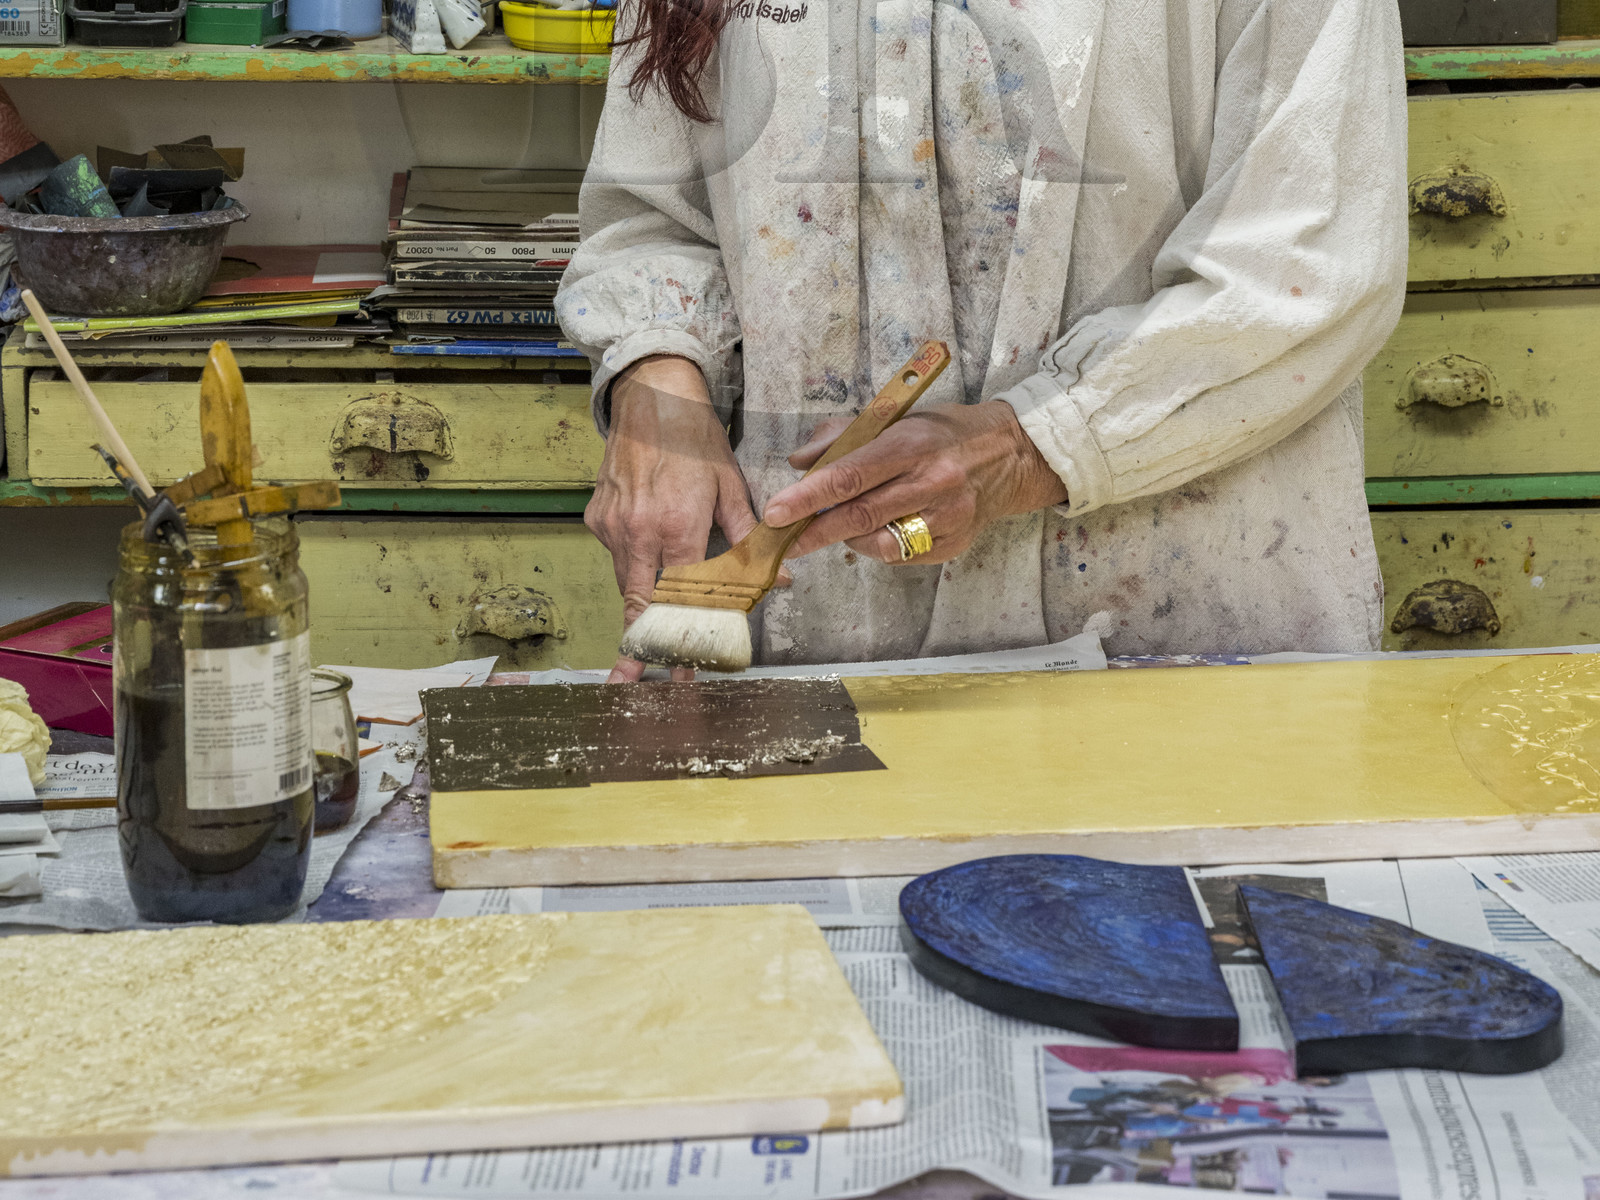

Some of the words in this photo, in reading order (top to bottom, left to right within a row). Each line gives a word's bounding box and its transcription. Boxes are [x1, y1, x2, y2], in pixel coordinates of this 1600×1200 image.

[405, 246, 434, 255] 02007
[484, 247, 496, 255] 50
[512, 246, 536, 256] P800
[446, 310, 471, 324] 62
[472, 310, 504, 324] PW
[147, 334, 169, 343] 100
[920, 346, 942, 366] 50
[1053, 659, 1078, 667] Monde
